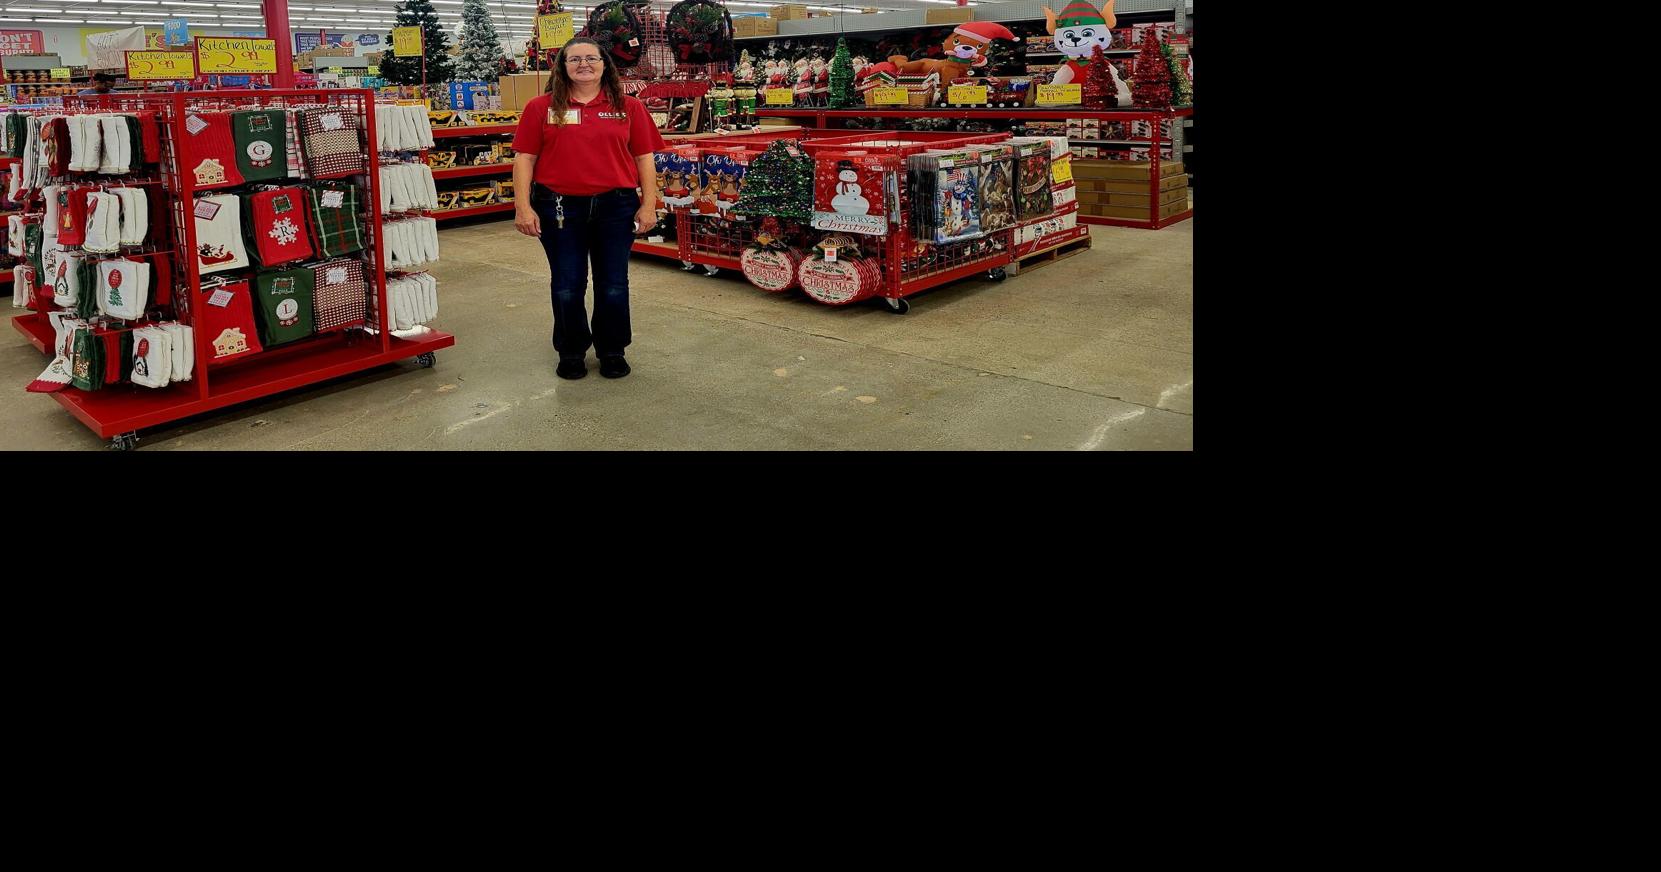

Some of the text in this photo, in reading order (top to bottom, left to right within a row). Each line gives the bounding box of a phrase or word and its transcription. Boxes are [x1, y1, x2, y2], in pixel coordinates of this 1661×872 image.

[0, 33, 32, 43] ON'T
[199, 39, 249, 51] Kitchen
[128, 51, 165, 61] Kitchen
[252, 144, 266, 156] G
[835, 215, 872, 223] MERRY
[280, 226, 289, 237] R
[817, 219, 882, 234] Christmas
[802, 275, 855, 293] CHRISTMAS
[284, 304, 293, 315] L
